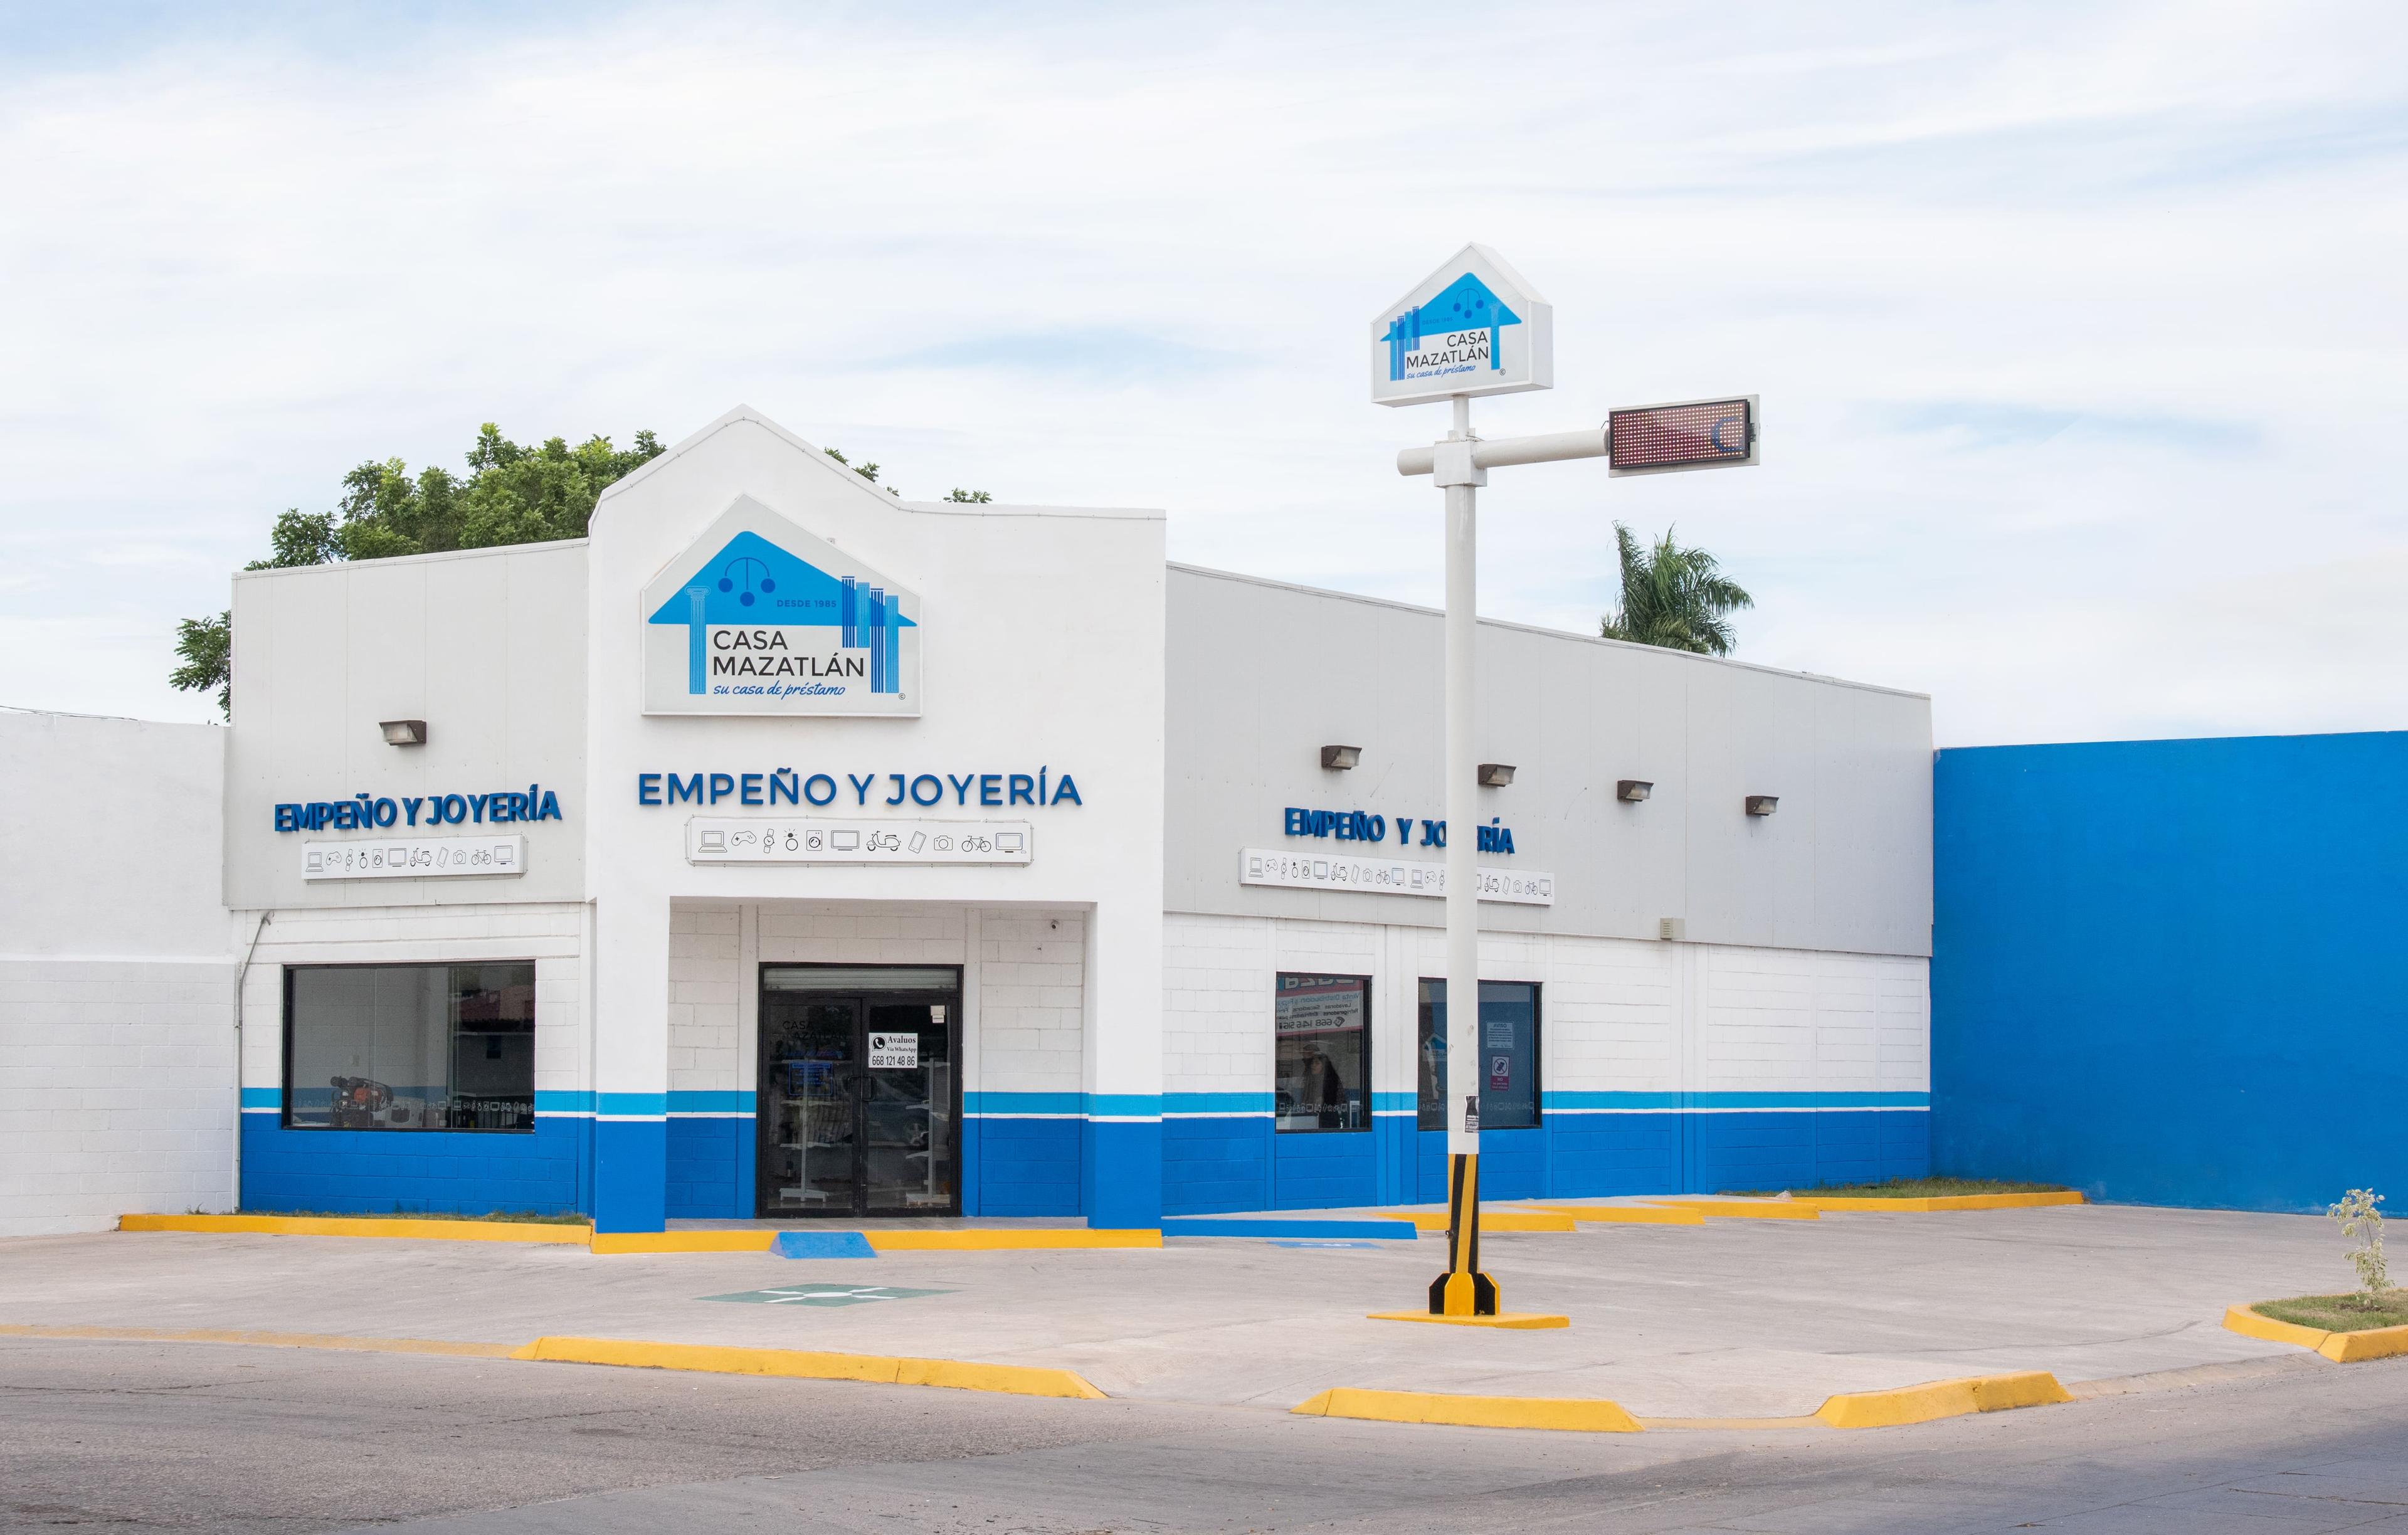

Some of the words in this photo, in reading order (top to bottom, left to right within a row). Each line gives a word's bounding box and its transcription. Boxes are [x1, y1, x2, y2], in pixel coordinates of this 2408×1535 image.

[1447, 331, 1488, 347] CASA
[1407, 346, 1489, 369] MAZATLÁN
[1417, 369, 1434, 377] casa
[1434, 366, 1442, 376] de
[1441, 364, 1476, 377] préstamo
[777, 599, 811, 608] DESDE
[713, 630, 788, 650] CASA
[714, 652, 863, 677] MAZATLÁN
[714, 685, 729, 695] su
[732, 686, 763, 695] casa
[767, 680, 782, 695] de
[781, 681, 845, 700] préstamo
[638, 767, 837, 806] EMPEÑO
[848, 774, 875, 805] Y
[886, 765, 1082, 806] JOYERÍA
[275, 793, 398, 831] EMPEÑO
[401, 798, 423, 826] Y
[425, 784, 562, 826] JOYERÍA
[1284, 808, 1386, 841] EMPEÑO
[1396, 818, 1413, 845] Y
[1420, 817, 1515, 853] JORÍA
[887, 1035, 916, 1043] Avaluos
[872, 1055, 884, 1065] 668
[886, 1056, 895, 1065] 121
[897, 1056, 906, 1066] 48
[907, 1056, 915, 1066] 86
